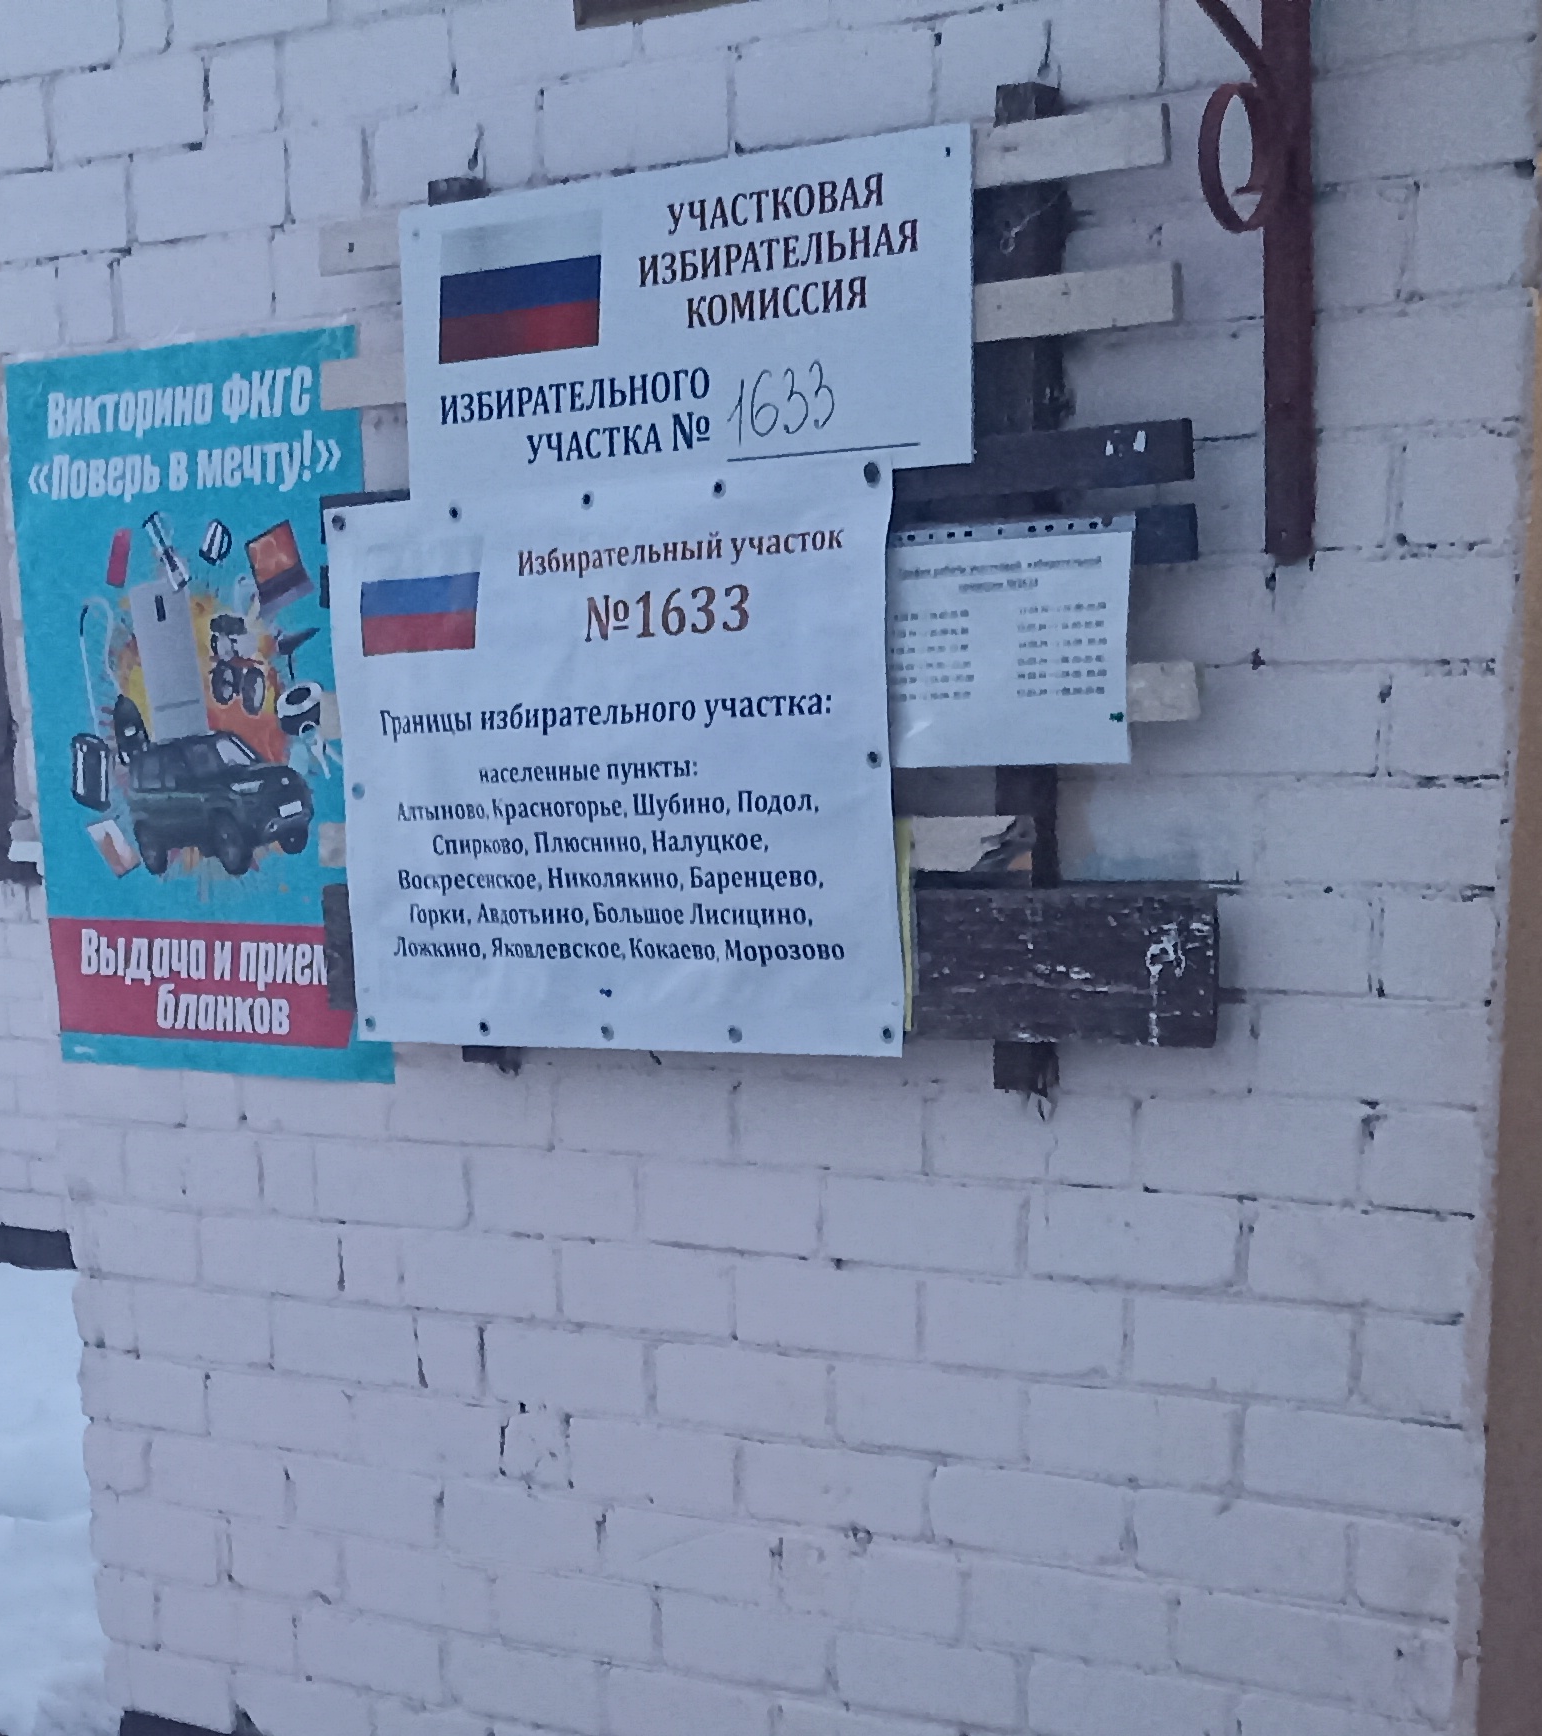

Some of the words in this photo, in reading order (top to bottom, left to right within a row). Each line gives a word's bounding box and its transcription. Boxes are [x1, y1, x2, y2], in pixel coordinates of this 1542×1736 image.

[667, 172, 883, 236] УЧАСТКОВАЯ
[638, 218, 919, 287] ИЗБИРАТЕЛЬНАЯ
[686, 275, 868, 329] КОМИССИЯ
[47, 382, 213, 439] Викторина
[221, 365, 312, 423] ФКГС
[439, 366, 711, 425] ИЗБИРАТЕЛЬНОГО
[526, 423, 662, 464] УЧАСТКА
[671, 410, 711, 453] №
[726, 358, 835, 447] 1633
[28, 454, 161, 502] «Поверь
[168, 451, 188, 491] в
[196, 429, 342, 492] мечту!»
[517, 531, 723, 578] Избирательный
[730, 528, 845, 565] участок
[584, 583, 750, 643] №1633
[380, 709, 472, 743] Границы
[480, 699, 696, 735] избирательного
[704, 692, 832, 728] участка:
[478, 761, 601, 784] населенные
[606, 758, 698, 785] пункты:
[491, 798, 628, 825] Красногорье,
[632, 792, 731, 821] Шубино,
[738, 789, 819, 816] Подол,
[432, 834, 529, 860] Спирково,
[534, 831, 647, 856] Плюснино,
[651, 829, 769, 857] Налуцкое,
[397, 869, 542, 896] Воскресенское,
[547, 866, 684, 892] Николякино,
[689, 866, 824, 894] Баренцево,
[410, 903, 471, 930] Горки,
[477, 902, 589, 926] Авдотьино,
[593, 902, 684, 925] Большое
[689, 903, 813, 928] Лисицино,
[80, 928, 206, 986] Выдача
[213, 940, 232, 981] и
[393, 936, 487, 960] Ложкино,
[491, 937, 626, 961] Яковлевское,
[629, 937, 720, 963] Кокаево,
[724, 939, 845, 967] Морозово
[156, 983, 290, 1035] бланков
